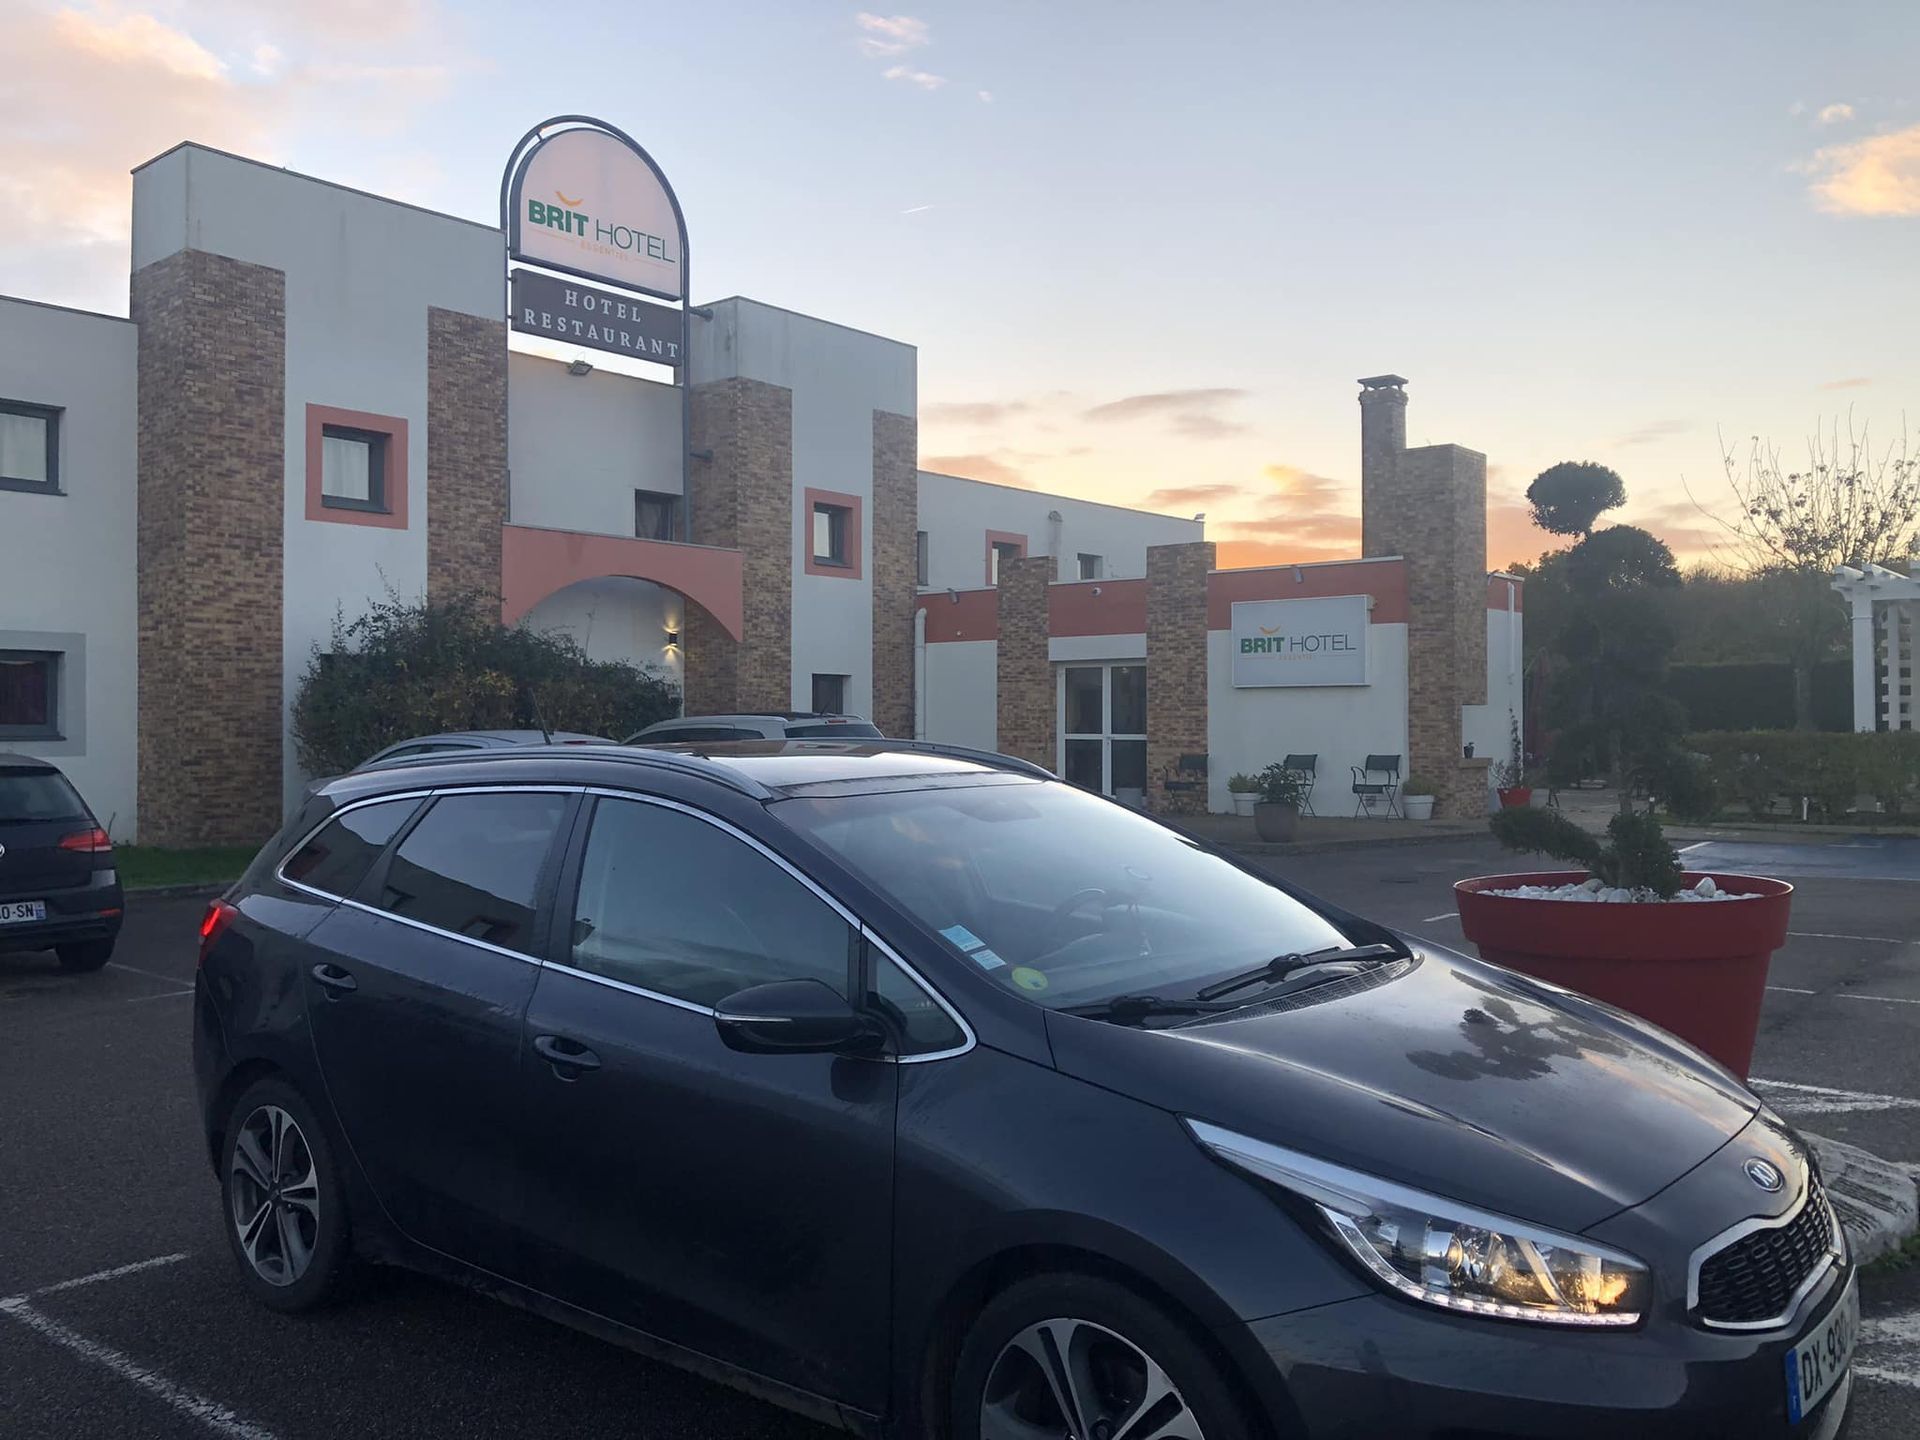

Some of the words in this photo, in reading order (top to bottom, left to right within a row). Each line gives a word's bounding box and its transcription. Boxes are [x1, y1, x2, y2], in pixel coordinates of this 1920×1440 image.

[528, 199, 589, 237] BRIT
[595, 218, 676, 264] HOTEL
[564, 288, 642, 323] HOTEL
[524, 307, 679, 358] RESTAURANT
[1240, 636, 1285, 654] BRIT
[1289, 633, 1357, 653] HOTEL
[0, 902, 34, 920] 0-SN
